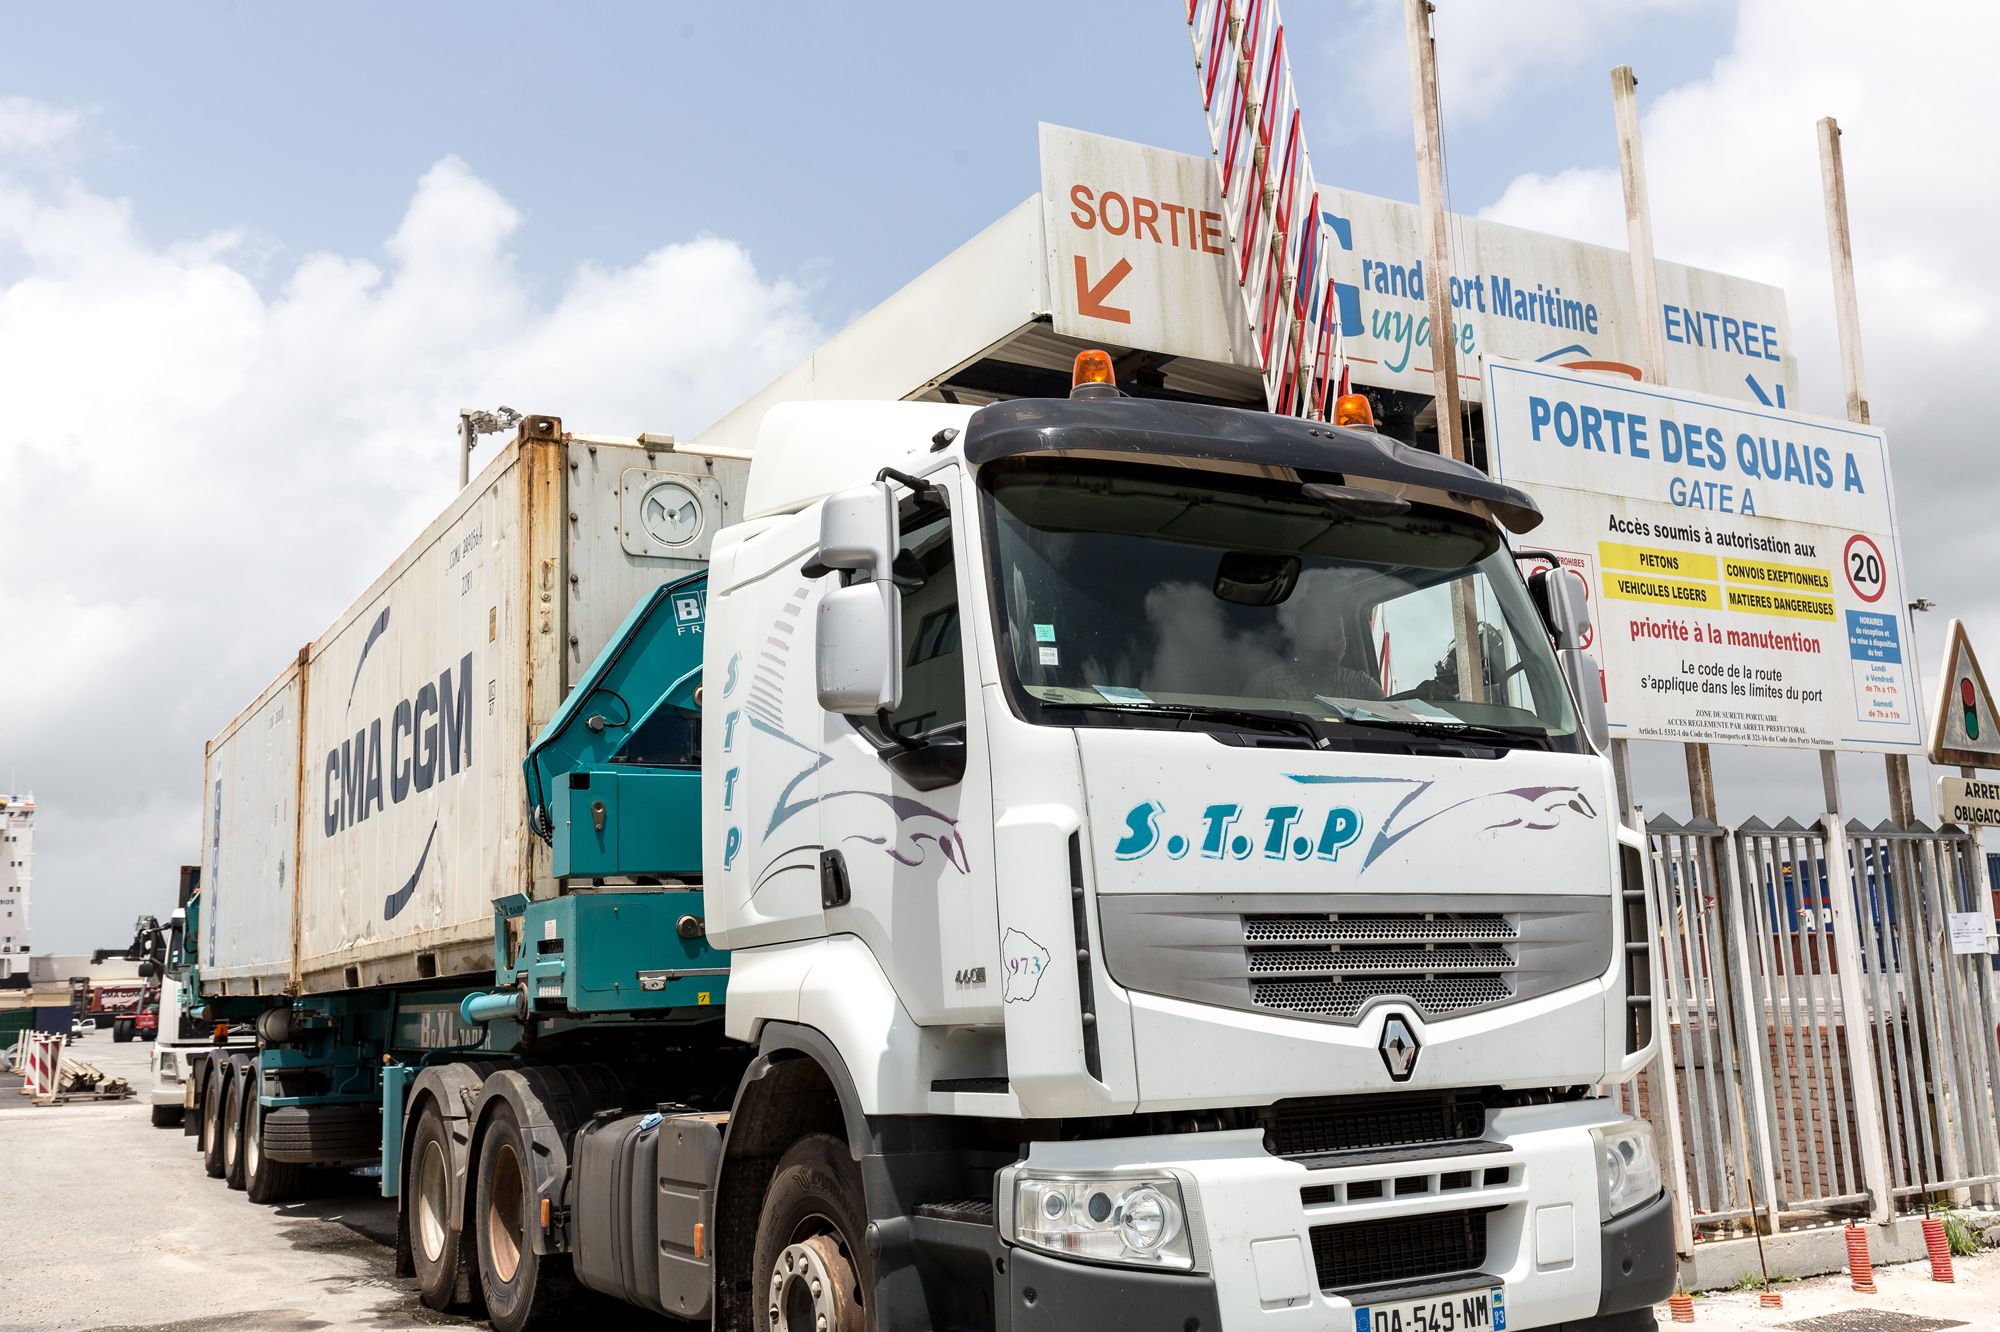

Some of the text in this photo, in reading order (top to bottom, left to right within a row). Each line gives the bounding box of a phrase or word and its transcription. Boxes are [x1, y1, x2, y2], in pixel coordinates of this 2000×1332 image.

[1070, 184, 1225, 256] SORTIE
[1449, 274, 1486, 313] ort
[1490, 274, 1598, 335] Maritime
[1663, 304, 1781, 363] ENTREE
[1529, 395, 1865, 494] PORTE DES QUAIS A
[1669, 476, 1757, 517] GATE A
[1608, 514, 1817, 558] Accès soumis à autorisation aux
[1639, 553, 1679, 570] PIETONS
[1850, 552, 1881, 584] 20
[1726, 564, 1829, 588] CONVOIS EXEPTIONNELS
[1617, 580, 1707, 602] VEHICULES LEGERS
[1728, 592, 1834, 616] MATIERES DANGEREUSES
[1629, 616, 1821, 654] priorité à la manutention
[1681, 659, 1783, 682] Le code de la route
[1870, 675, 1894, 683] Vendredi
[1701, 677, 1728, 695] dans
[1730, 681, 1746, 697] les
[1749, 683, 1783, 699] limites
[1786, 686, 1799, 701] du
[1802, 689, 1823, 704] port
[1695, 709, 1712, 718] ZONE
[1722, 711, 1744, 720] SURETE
[1745, 713, 1779, 722] PORTUAIRE
[1873, 700, 1893, 708] Samedi
[1638, 727, 1658, 736] Articles
[1689, 730, 1704, 738] Code
[1713, 731, 1741, 741] Transports
[1768, 734, 1775, 742] du
[1775, 735, 1789, 743] Code
[1797, 736, 1810, 745] Ports
[1810, 737, 1834, 746] Maritimes
[1666, 718, 1807, 734] ACCES REGLEMENTE PAR ARRETE PREFECTORAL
[324, 651, 473, 838] CMA CGM
[1964, 781, 2000, 801] ARRET
[1954, 804, 2000, 825] OBLIGATO
[1010, 955, 1041, 976] 973
[1374, 1294, 1489, 1332] DA-549-NM
